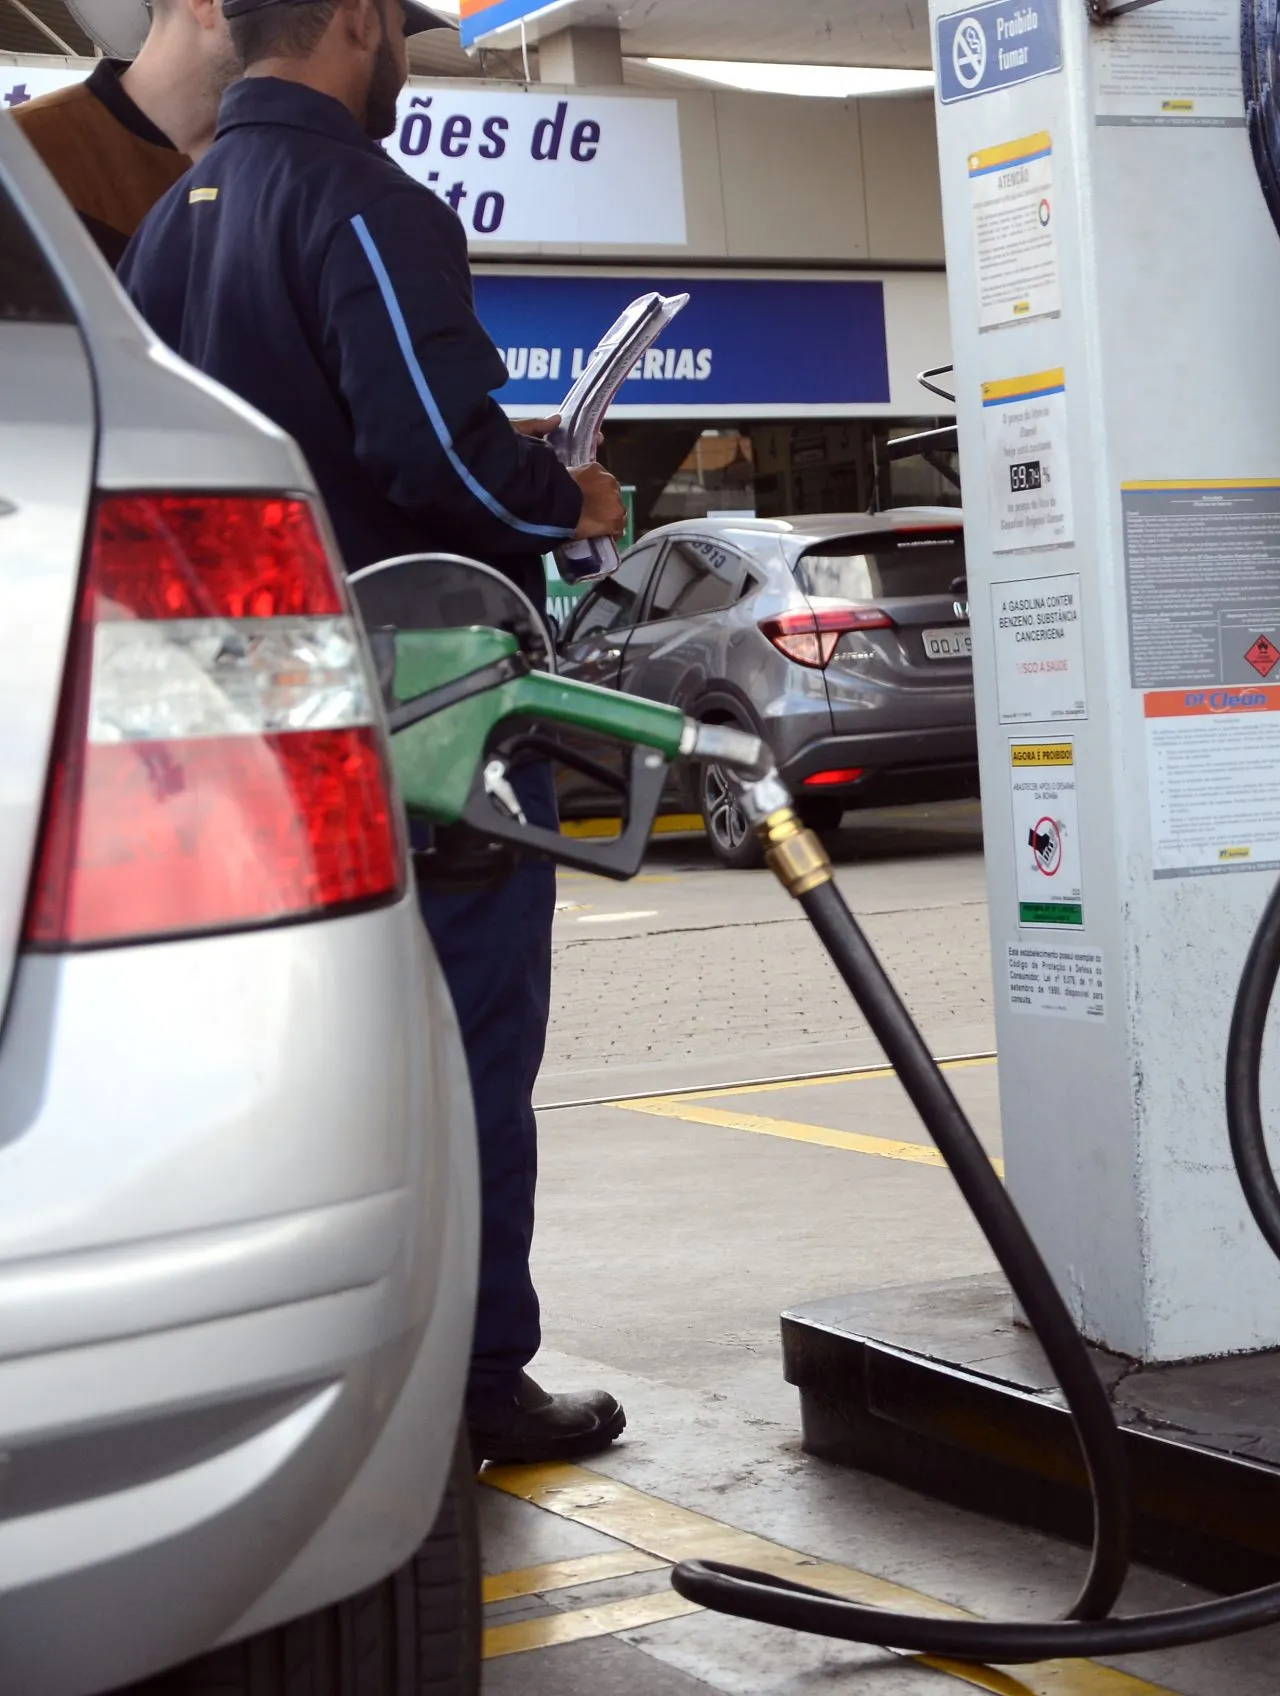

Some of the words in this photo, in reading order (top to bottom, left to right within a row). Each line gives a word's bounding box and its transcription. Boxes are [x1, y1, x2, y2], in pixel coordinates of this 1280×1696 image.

[996, 7, 1038, 41] Proibido
[998, 46, 1029, 71] fumar
[399, 96, 509, 159] ões
[531, 101, 601, 162] de
[998, 167, 1029, 190] ATENÇÃO
[1002, 602, 1007, 612] A
[1009, 599, 1045, 612] GASOLINA
[1209, 692, 1267, 708] Clean
[1013, 751, 1035, 761] AGORA
